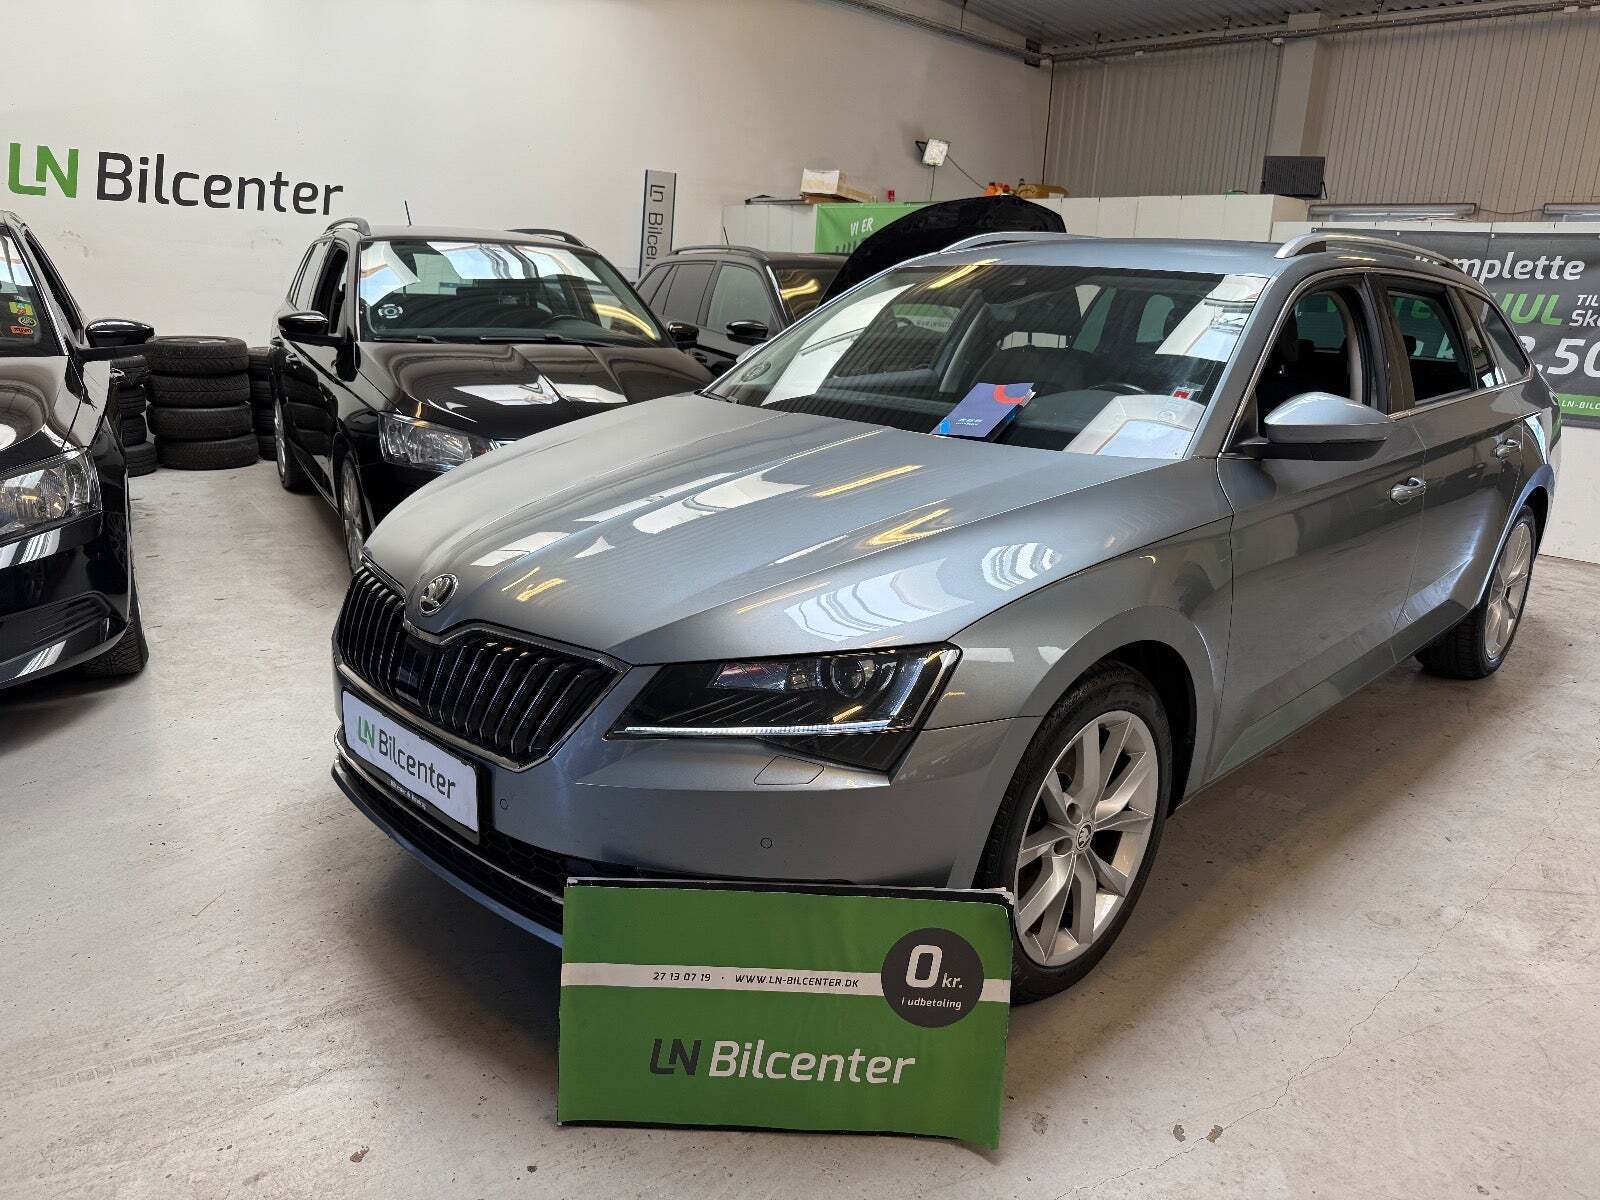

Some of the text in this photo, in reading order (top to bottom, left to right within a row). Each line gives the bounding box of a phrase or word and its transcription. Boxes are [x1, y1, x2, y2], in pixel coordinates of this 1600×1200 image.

[8, 143, 344, 216] LN Bilcenter
[850, 217, 874, 237] VI ER
[1415, 252, 1585, 285] mplette
[1577, 294, 1599, 306] TIL
[1569, 309, 1600, 327] Sk
[357, 716, 376, 749] LN
[378, 728, 456, 800] Bilcenter
[905, 944, 963, 989] 0 kr.
[653, 972, 859, 988] 27 13 07 19 WWW.LN-BILCENTER.DK
[907, 997, 962, 1011] udbetaling
[649, 1038, 916, 1084] LN Bilcenter
